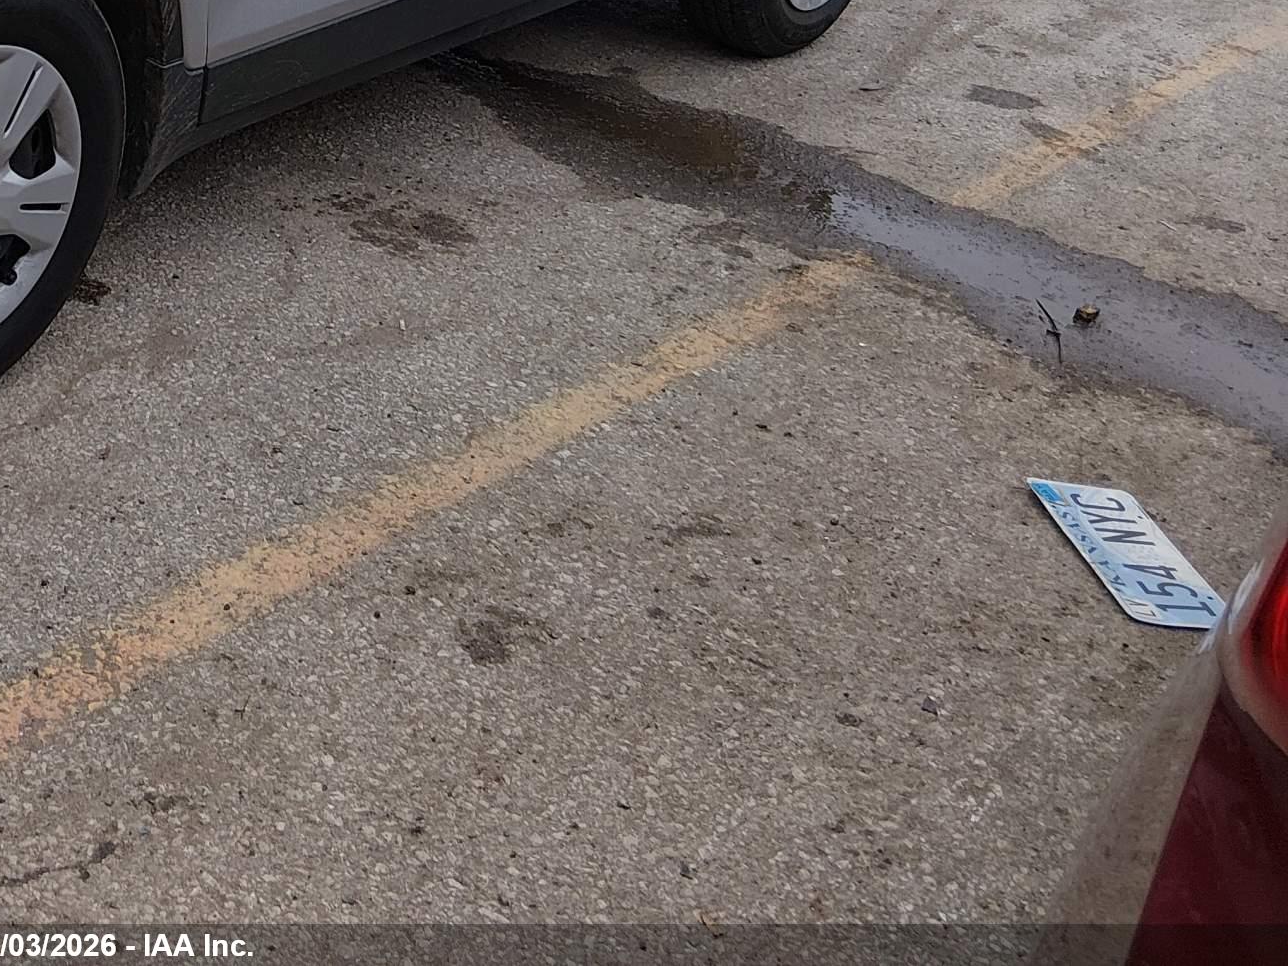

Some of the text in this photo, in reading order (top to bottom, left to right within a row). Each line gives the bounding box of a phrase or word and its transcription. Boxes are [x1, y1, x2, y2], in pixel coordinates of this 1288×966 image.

[1058, 511, 1126, 590] KANSAS
[1070, 493, 1217, 617] 154 NYC
